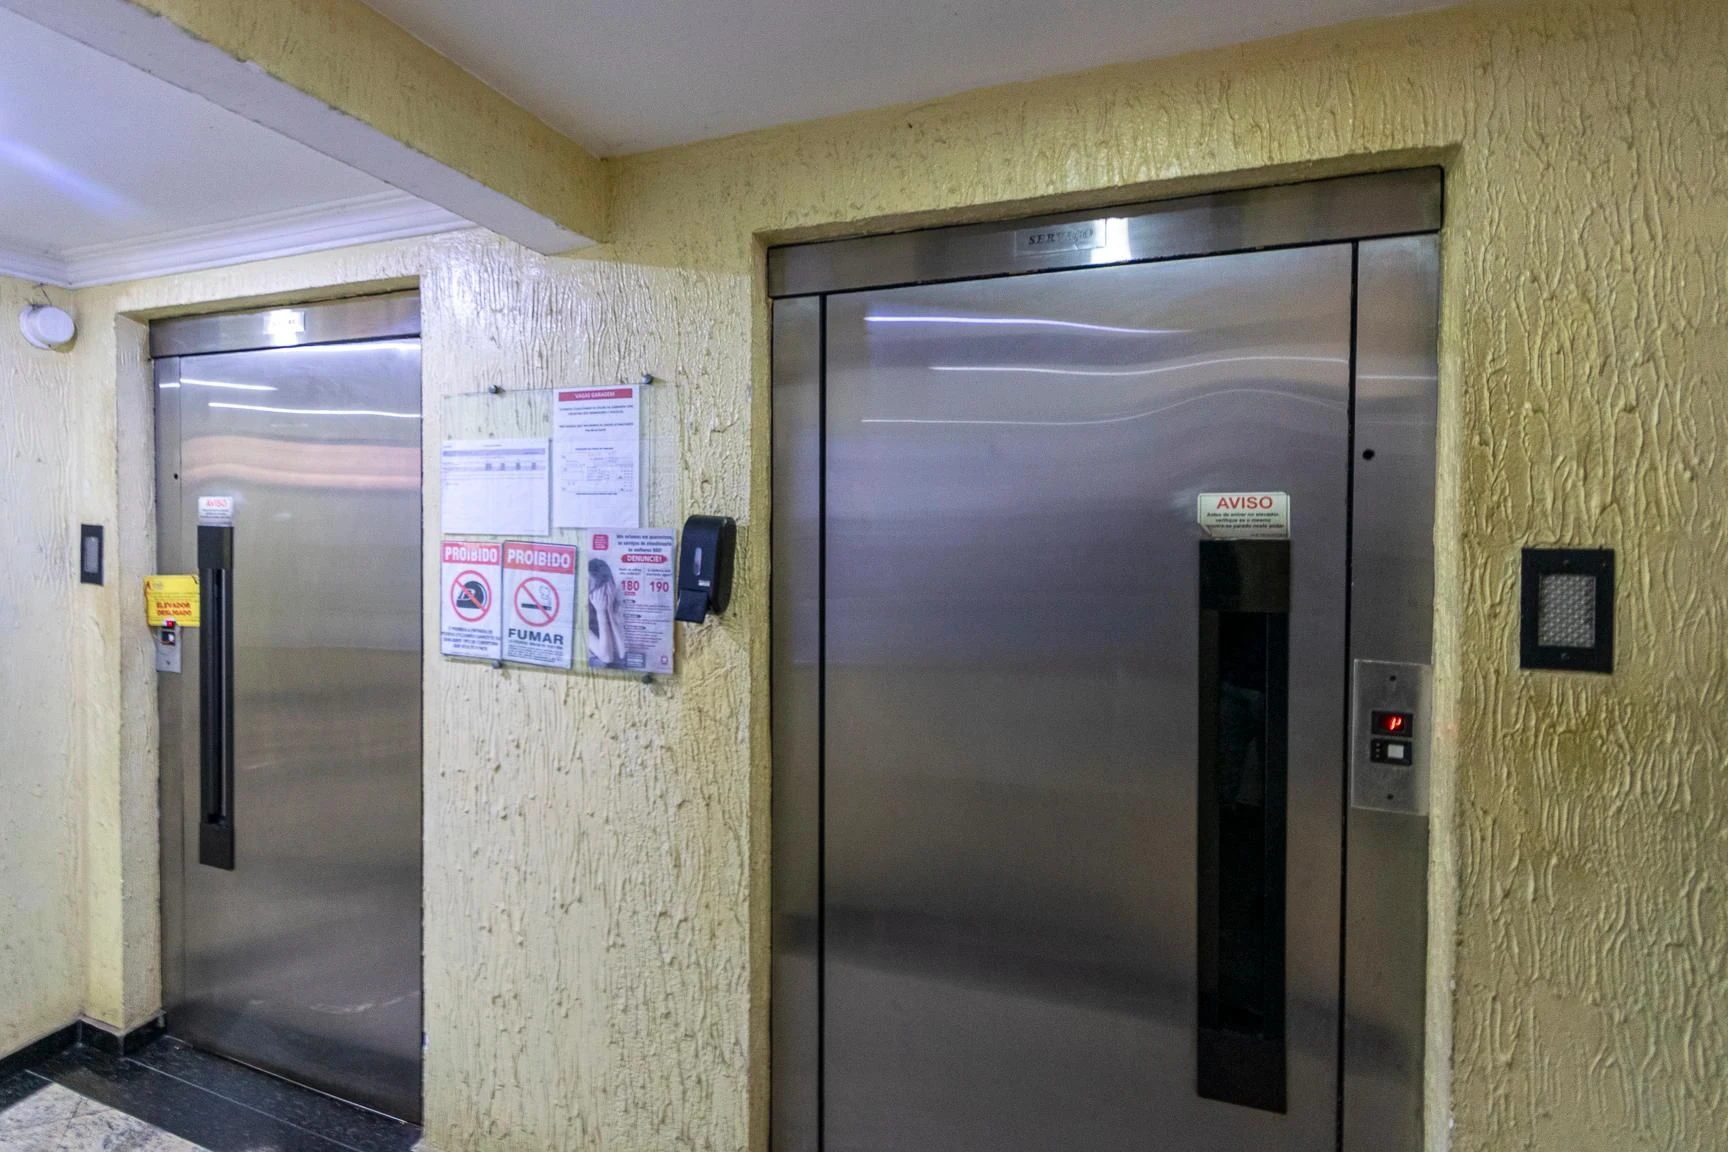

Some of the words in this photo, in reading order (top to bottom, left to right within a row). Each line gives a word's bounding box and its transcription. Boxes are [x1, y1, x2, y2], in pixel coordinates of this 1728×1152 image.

[1217, 496, 1273, 509] AVISO
[445, 546, 498, 563] PROIBIDO
[507, 548, 570, 569] PROIBIDO
[621, 580, 640, 591] 180
[650, 581, 669, 592] 190
[156, 601, 191, 609] ELEVADOR
[508, 628, 564, 645] FUMAR
